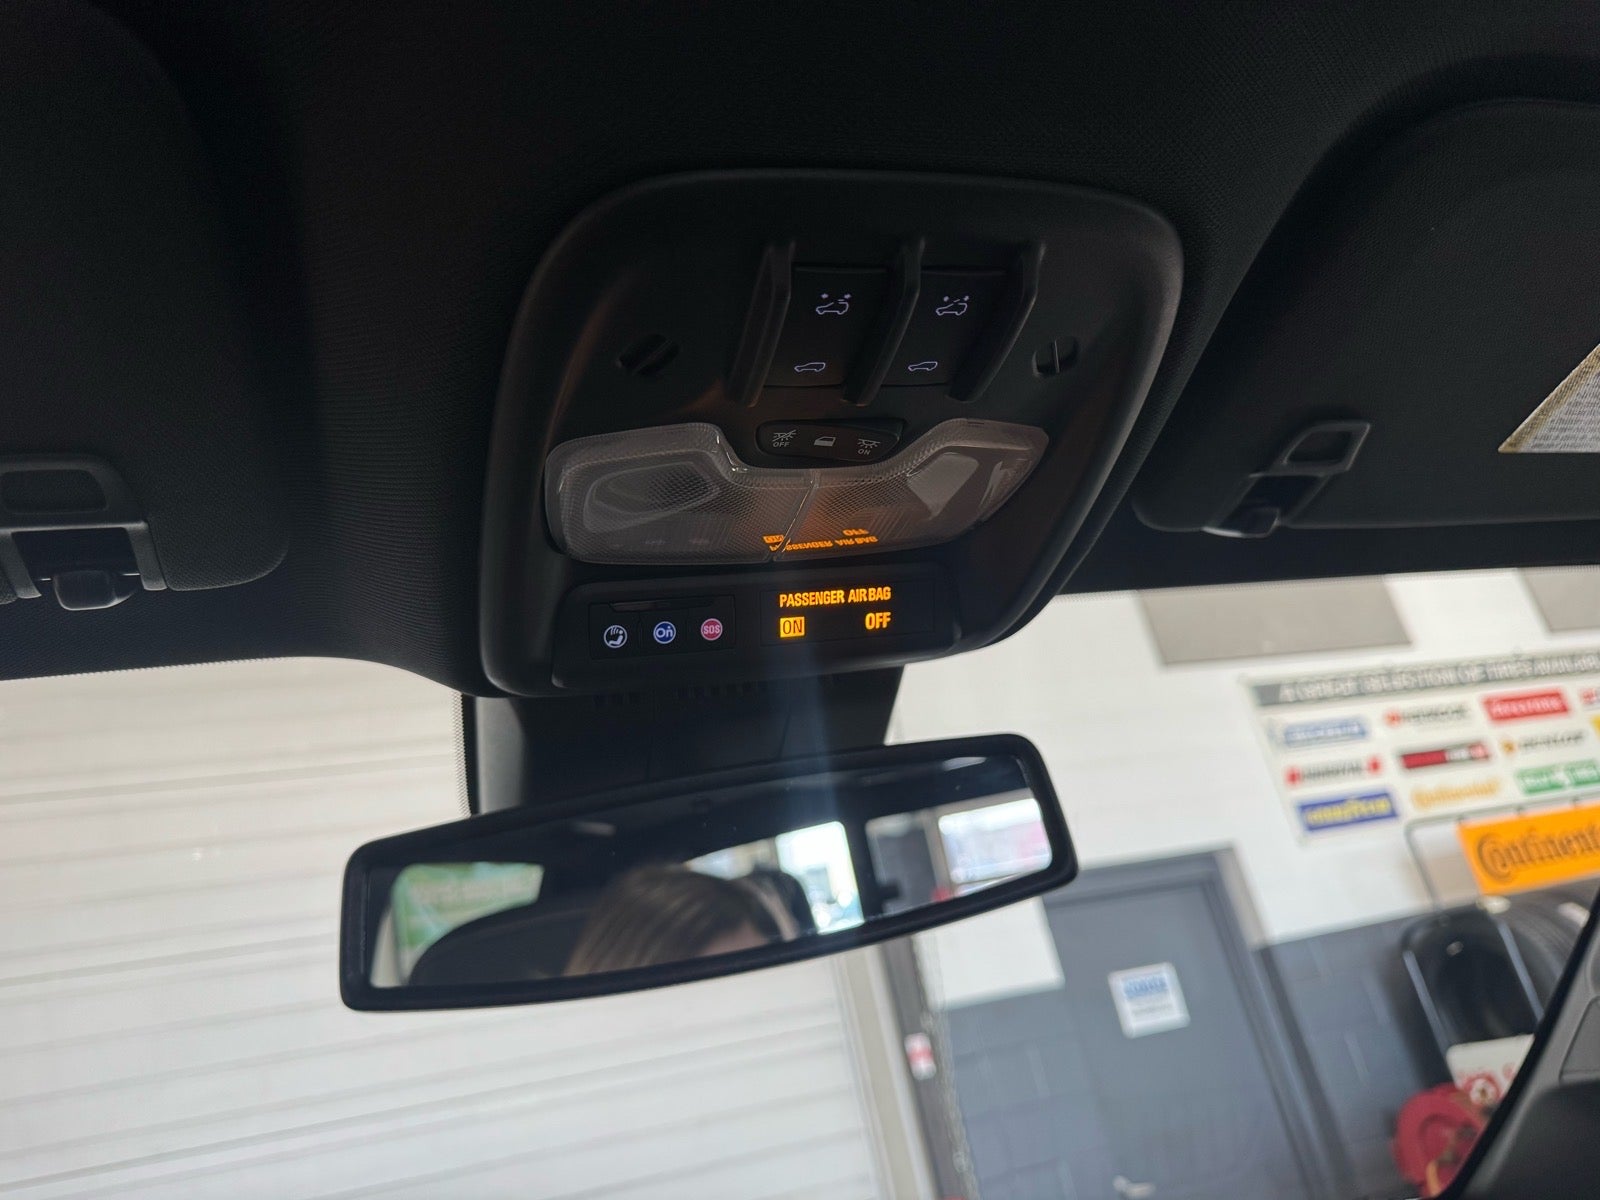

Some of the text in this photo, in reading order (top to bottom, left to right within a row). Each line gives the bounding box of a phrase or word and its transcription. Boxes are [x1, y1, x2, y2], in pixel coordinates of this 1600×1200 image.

[857, 448, 871, 456] ON
[778, 588, 845, 607] PASSENGER
[703, 624, 720, 635] SOS
[781, 618, 804, 637] ON
[865, 611, 891, 630] OFF
